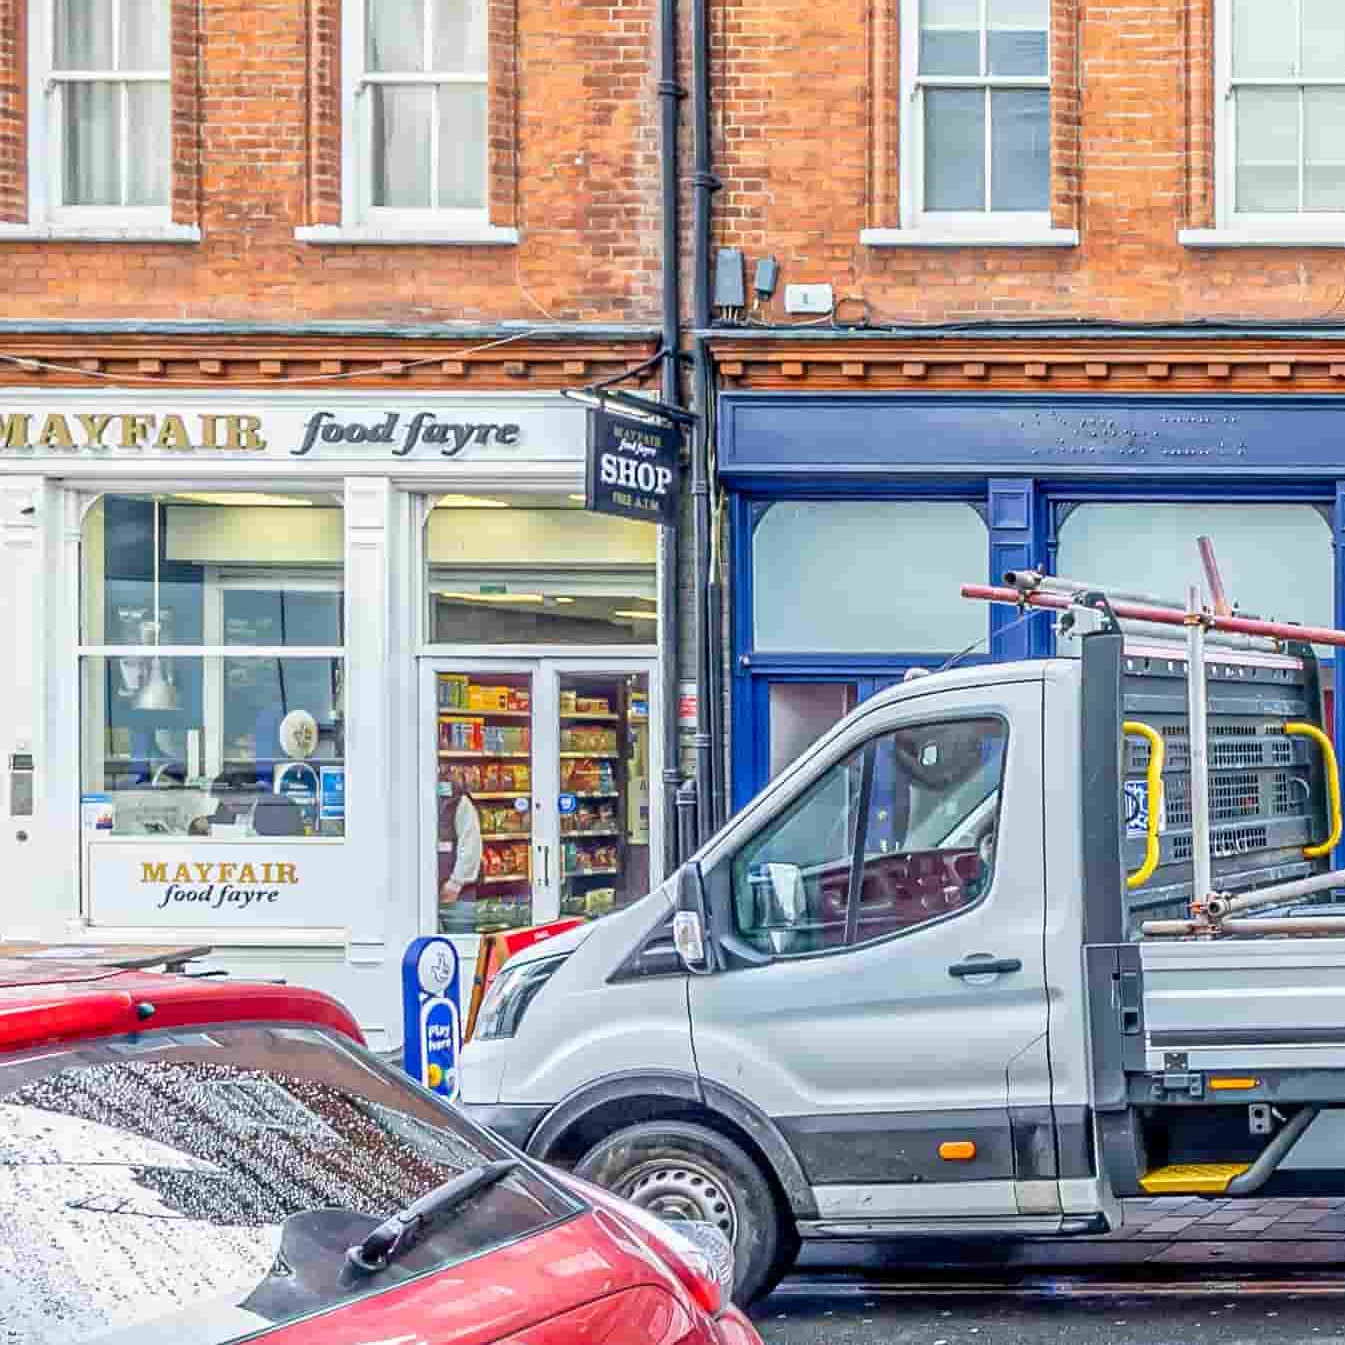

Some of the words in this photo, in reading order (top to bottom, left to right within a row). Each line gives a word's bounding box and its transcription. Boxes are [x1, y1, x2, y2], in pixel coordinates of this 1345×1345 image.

[0, 413, 268, 451] MAYFAIR
[290, 411, 401, 456] food
[391, 411, 520, 457] fayre
[600, 453, 672, 495] SHOP
[140, 861, 299, 885] MAYFAIR
[157, 884, 214, 909] food
[211, 884, 280, 909] fayre
